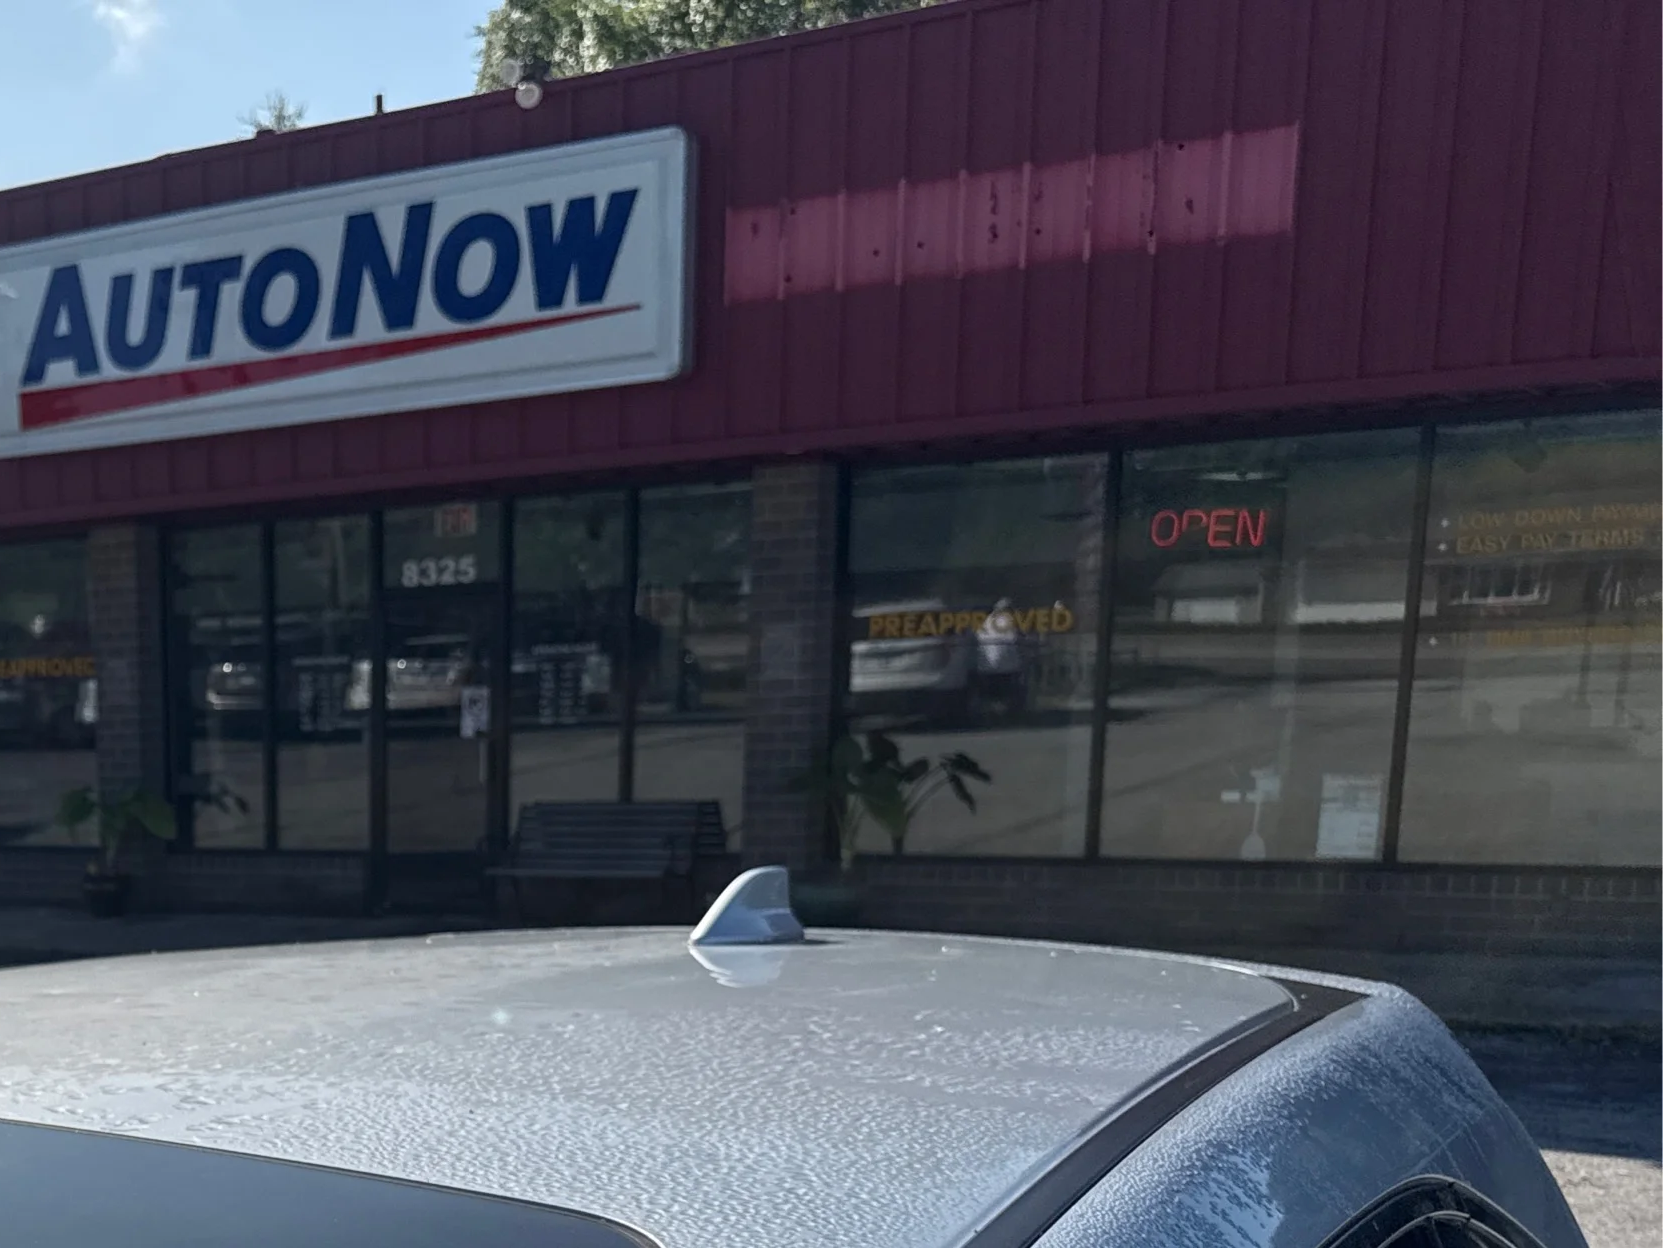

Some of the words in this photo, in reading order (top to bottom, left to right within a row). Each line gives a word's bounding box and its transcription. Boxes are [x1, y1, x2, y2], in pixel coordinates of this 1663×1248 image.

[1150, 508, 1267, 549] OPEN
[1458, 512, 1505, 530] LOW
[1514, 507, 1582, 526] DOWN
[1456, 534, 1512, 555] EASY
[1520, 531, 1558, 551] PAY
[401, 554, 477, 588] 8325
